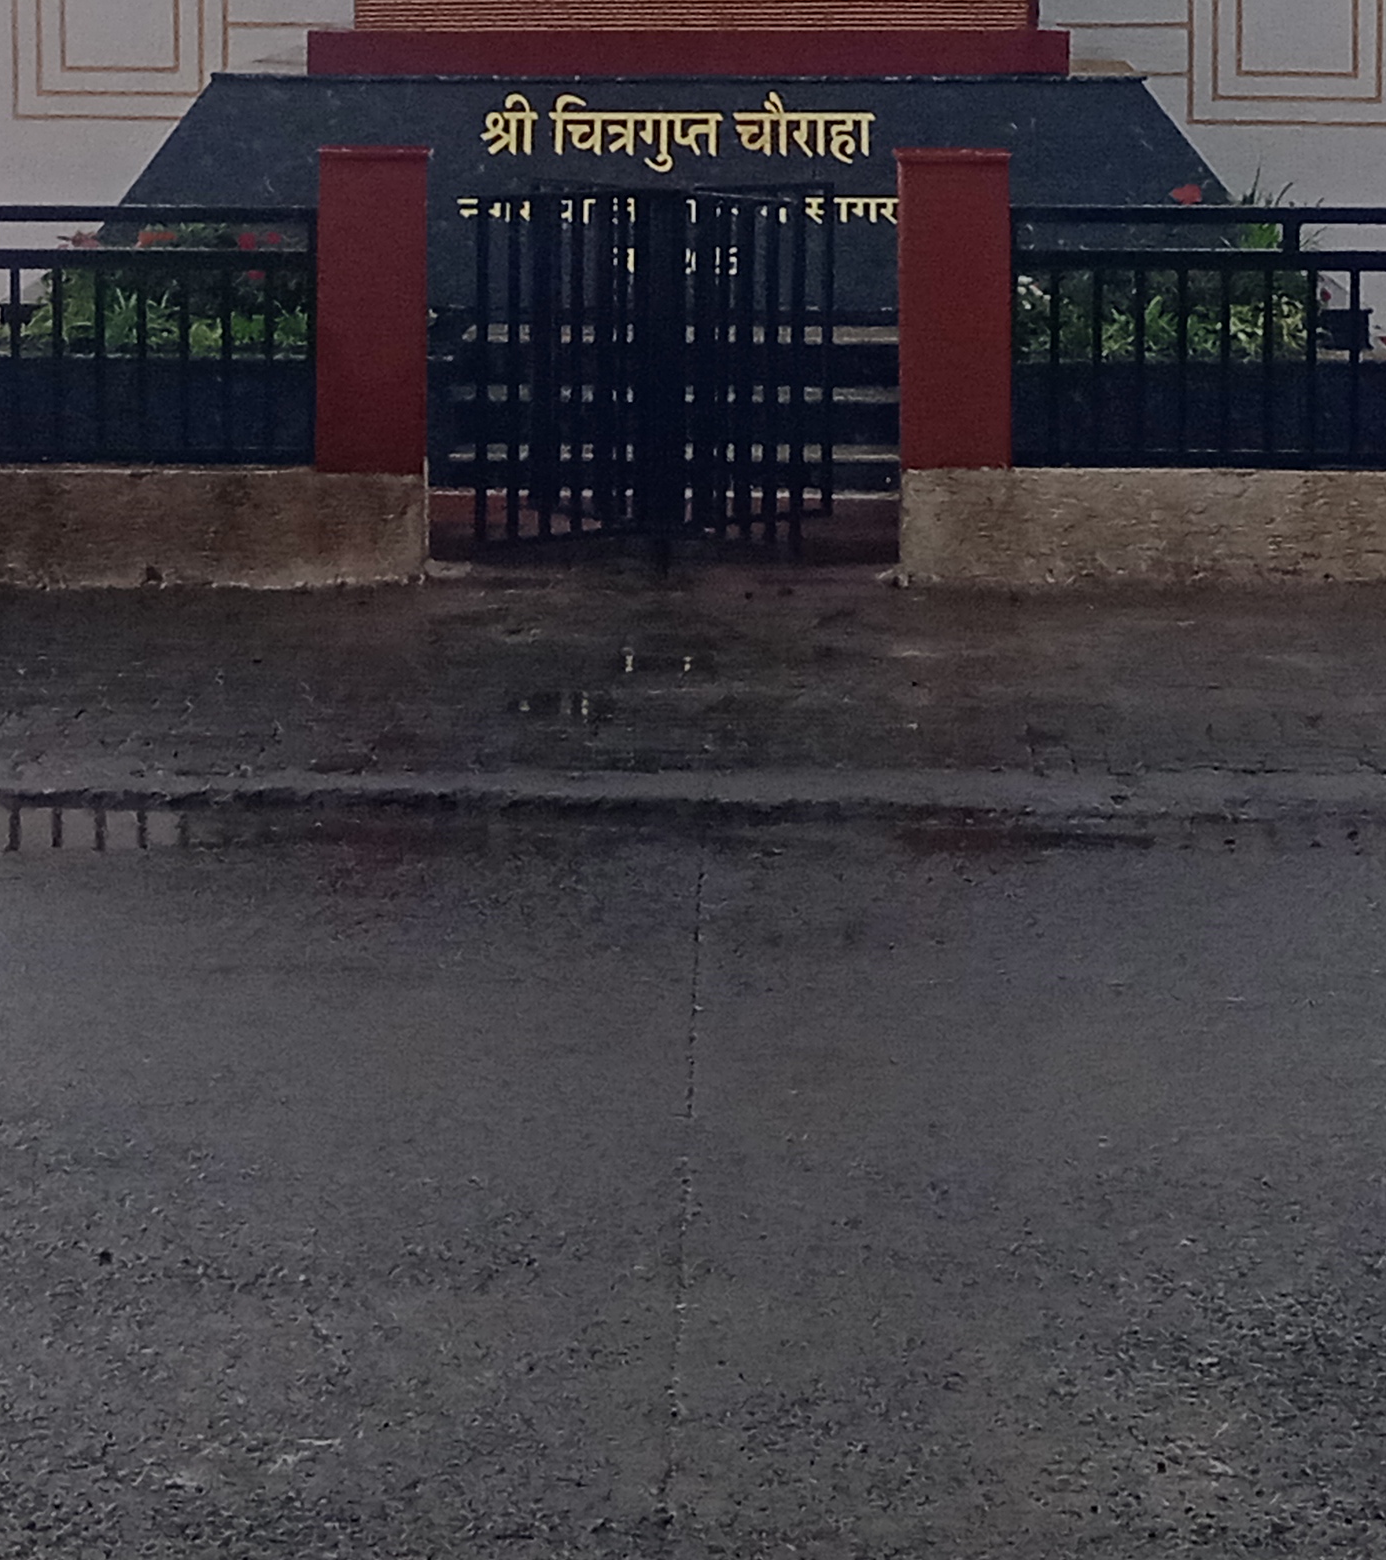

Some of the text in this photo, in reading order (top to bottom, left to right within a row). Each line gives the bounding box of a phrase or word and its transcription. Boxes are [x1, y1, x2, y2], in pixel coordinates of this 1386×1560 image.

[480, 91, 876, 172] श्री चित्रगुप्त चौराहा
